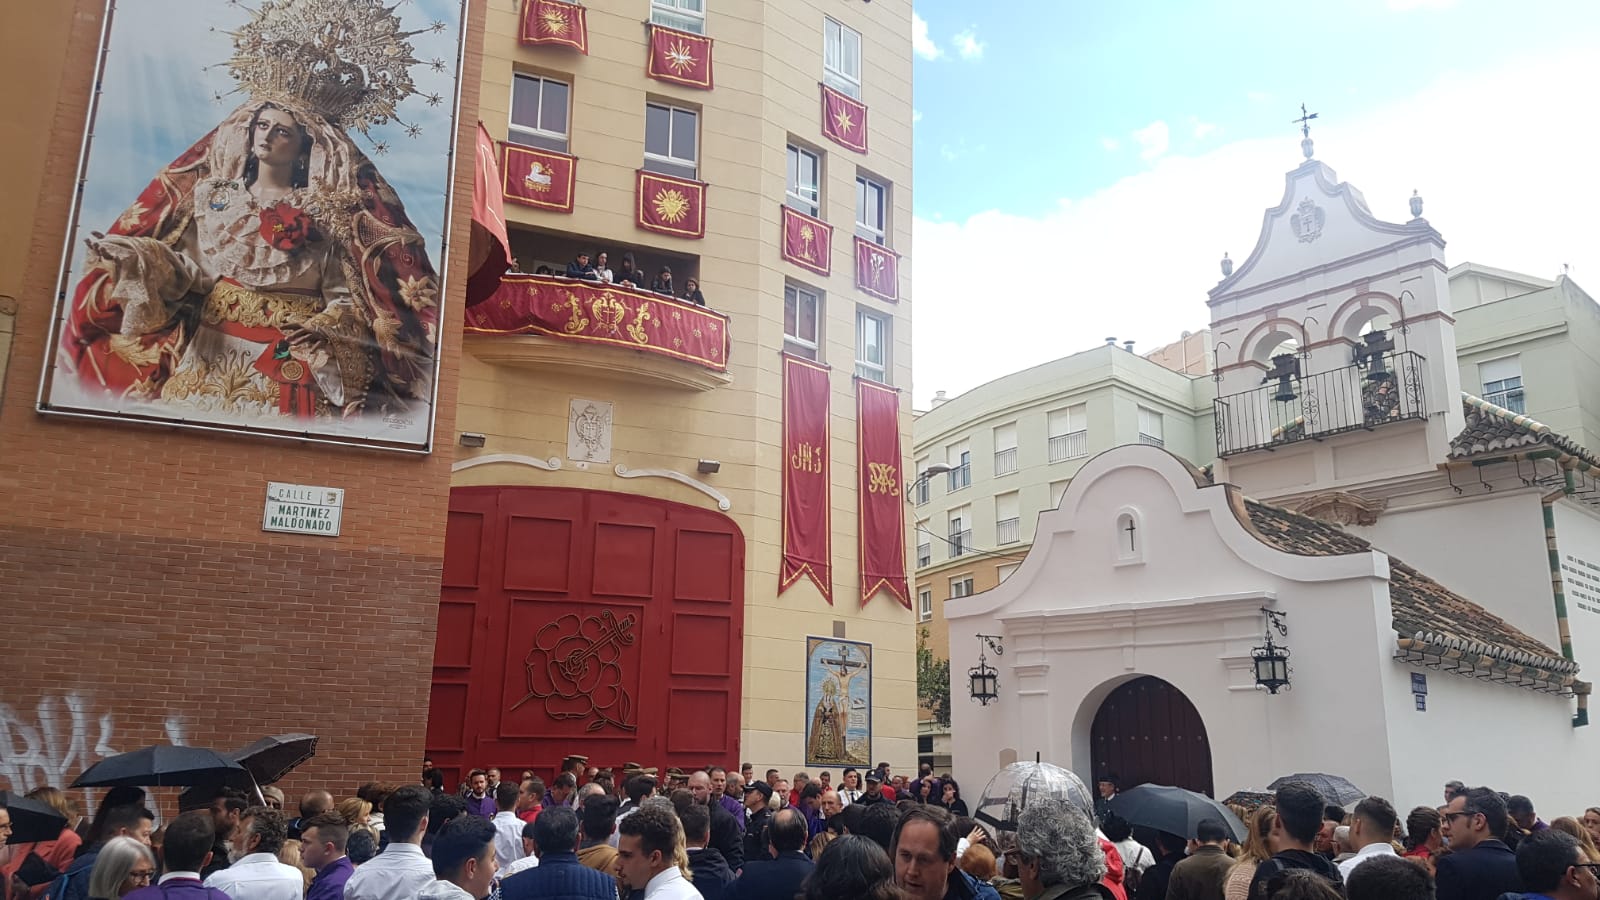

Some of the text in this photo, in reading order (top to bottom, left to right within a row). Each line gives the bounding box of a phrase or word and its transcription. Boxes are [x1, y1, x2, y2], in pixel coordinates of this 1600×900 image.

[278, 488, 312, 501] CALLE
[278, 504, 331, 519] MARTINEZ
[270, 516, 332, 531] MALDONADO
